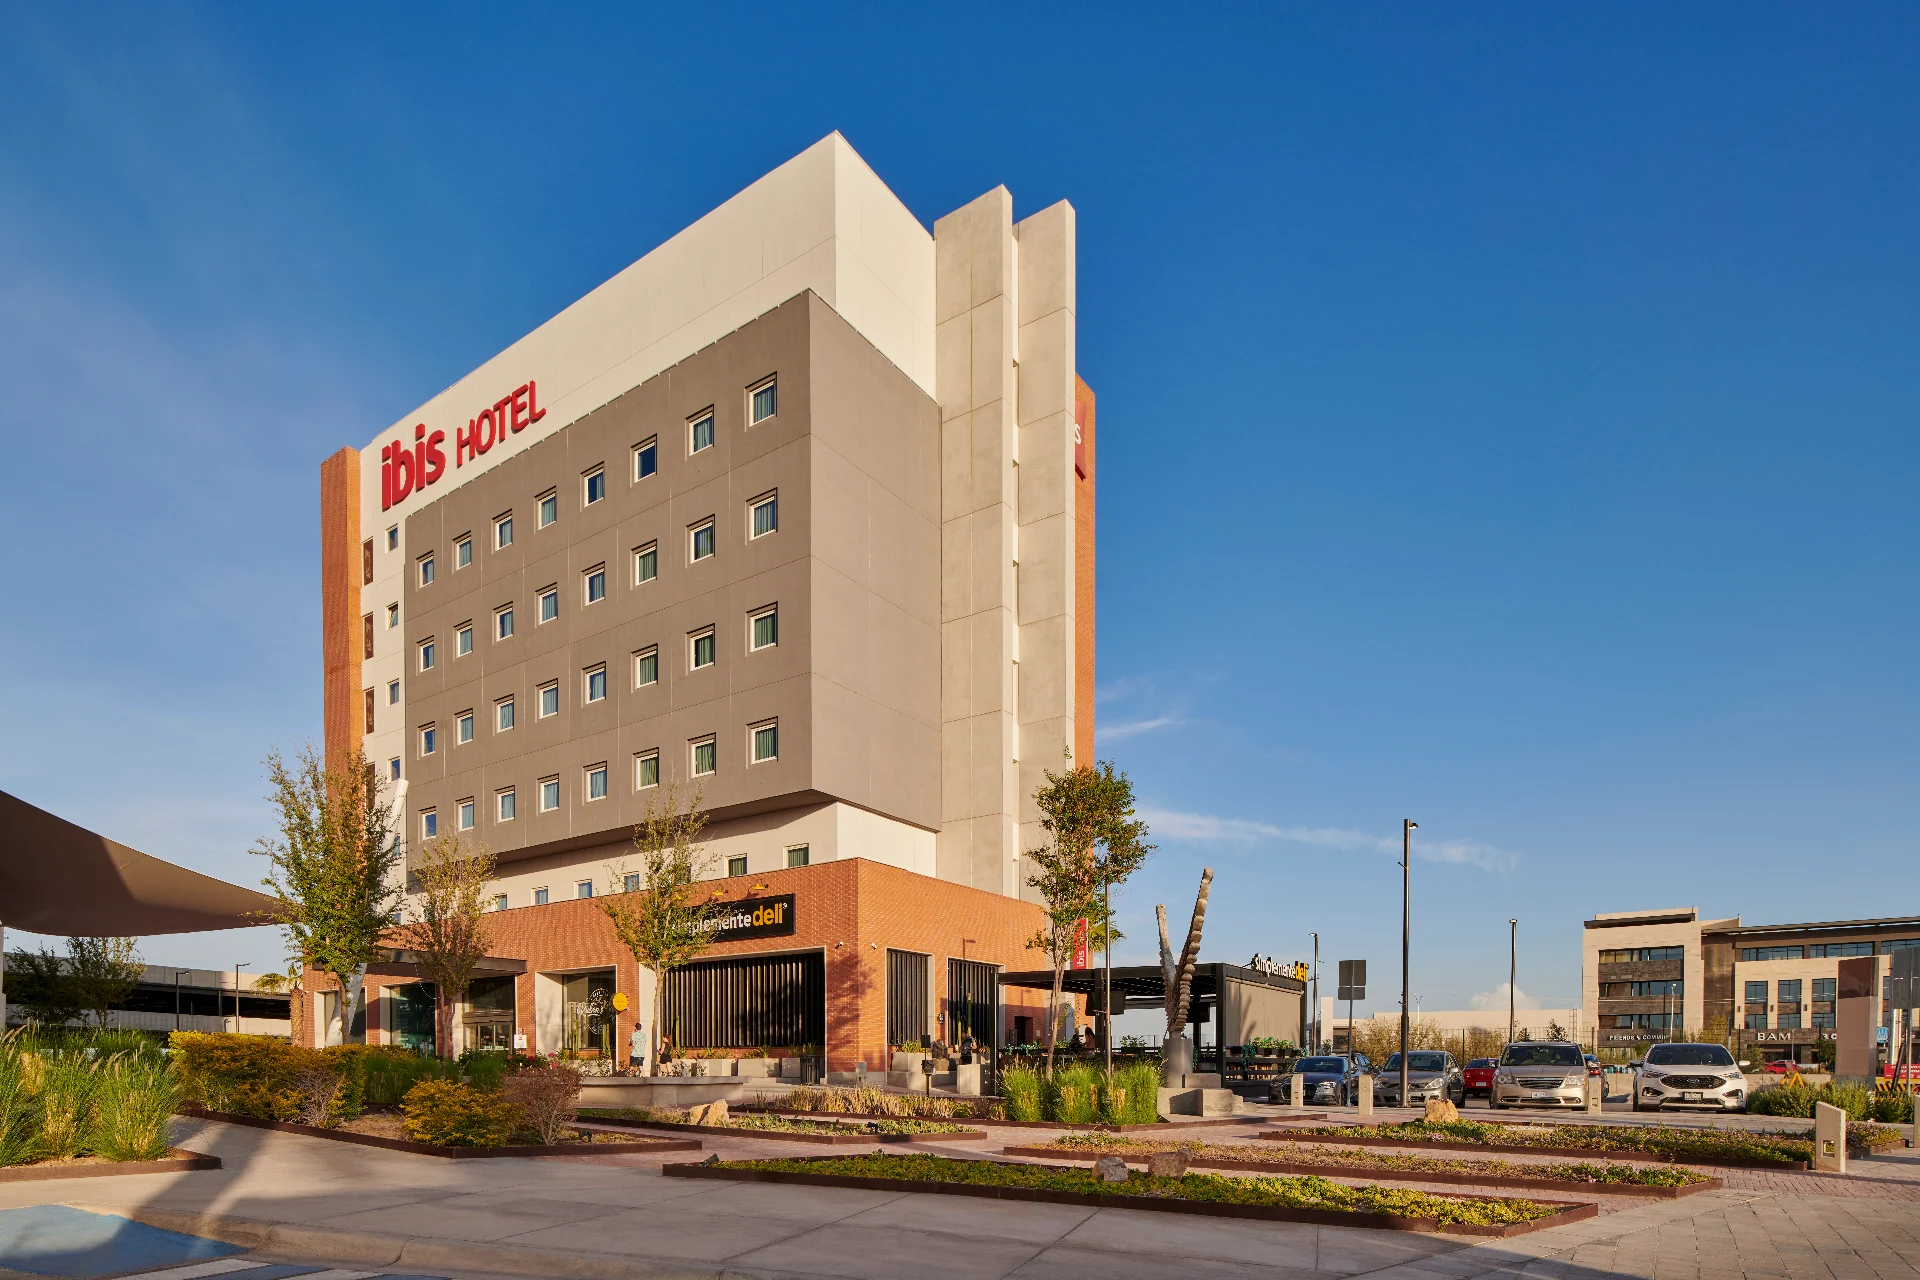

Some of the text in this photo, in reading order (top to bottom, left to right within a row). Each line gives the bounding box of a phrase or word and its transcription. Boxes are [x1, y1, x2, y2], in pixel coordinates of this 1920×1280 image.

[382, 380, 547, 512] ibis HOTEL
[1076, 950, 1085, 967] ibis
[1757, 1032, 1791, 1041] BAM
